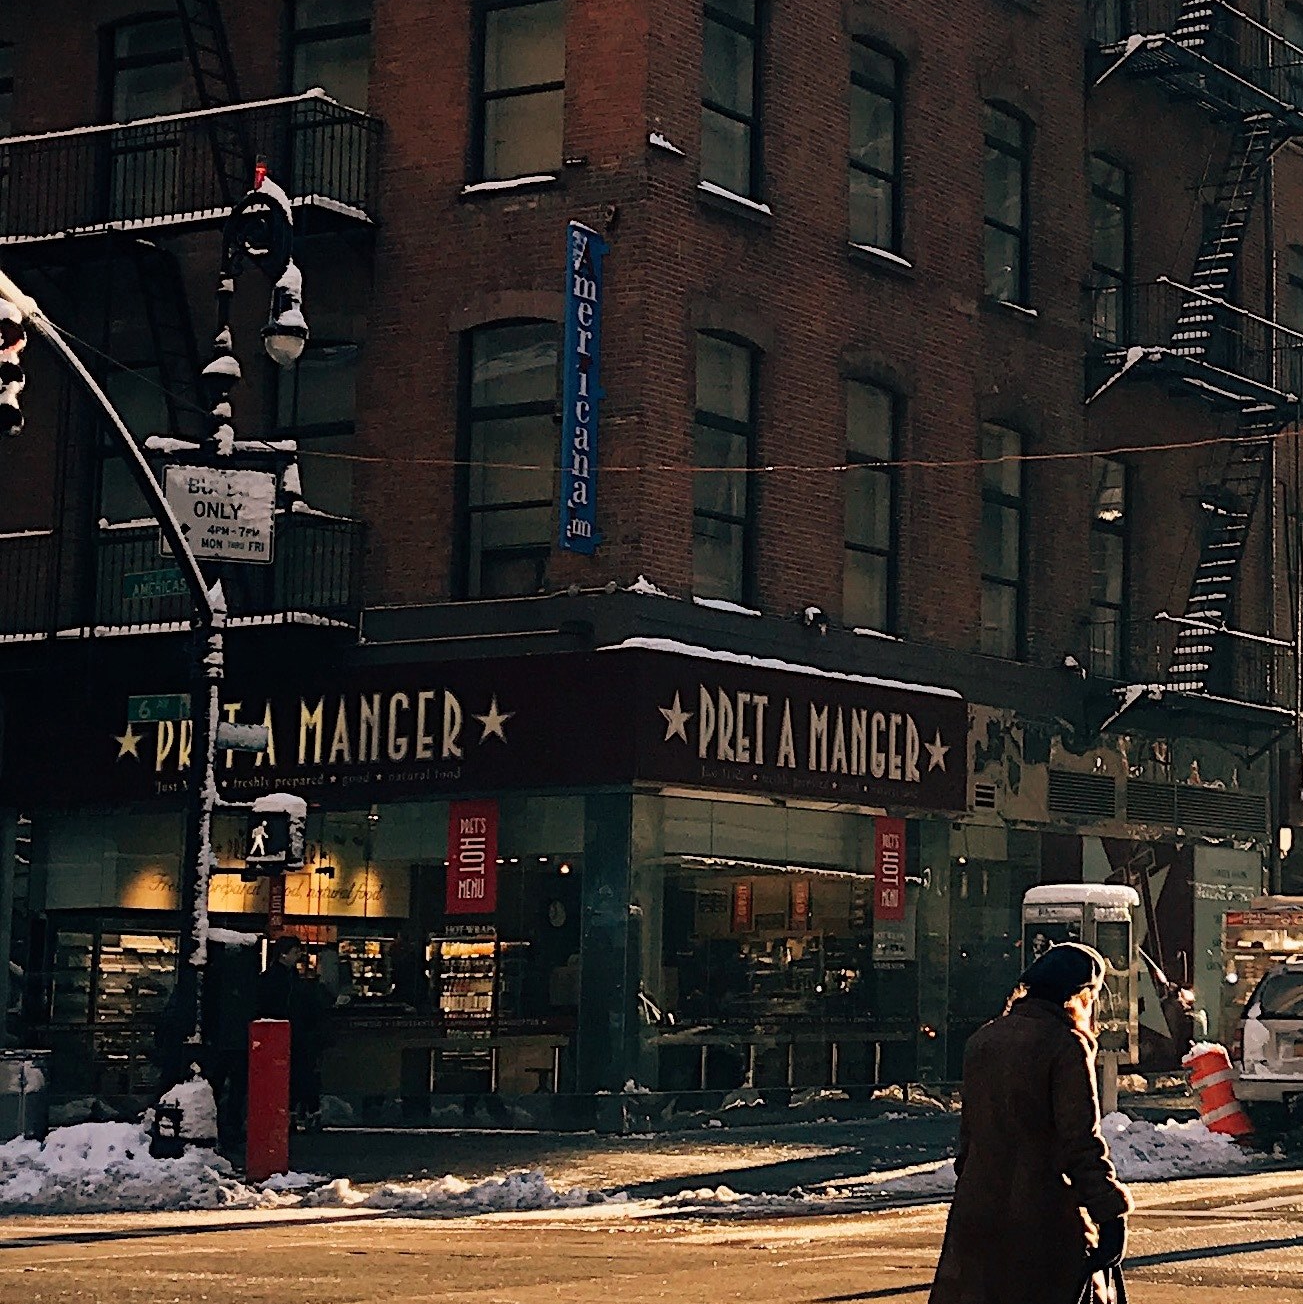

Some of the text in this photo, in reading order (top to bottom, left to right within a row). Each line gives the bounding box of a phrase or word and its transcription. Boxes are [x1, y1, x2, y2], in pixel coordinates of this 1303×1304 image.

[194, 500, 242, 520] ONLY
[202, 537, 223, 549] MON
[248, 541, 265, 553] FRI
[138, 699, 151, 720] 6
[155, 688, 464, 773] PRT A MANGER
[699, 683, 769, 766] PRET
[776, 697, 797, 770] A
[809, 701, 921, 784] MANGER
[274, 773, 325, 790] prepared
[459, 837, 486, 875] HOT
[881, 851, 900, 887] HOT
[458, 878, 485, 899] MENU
